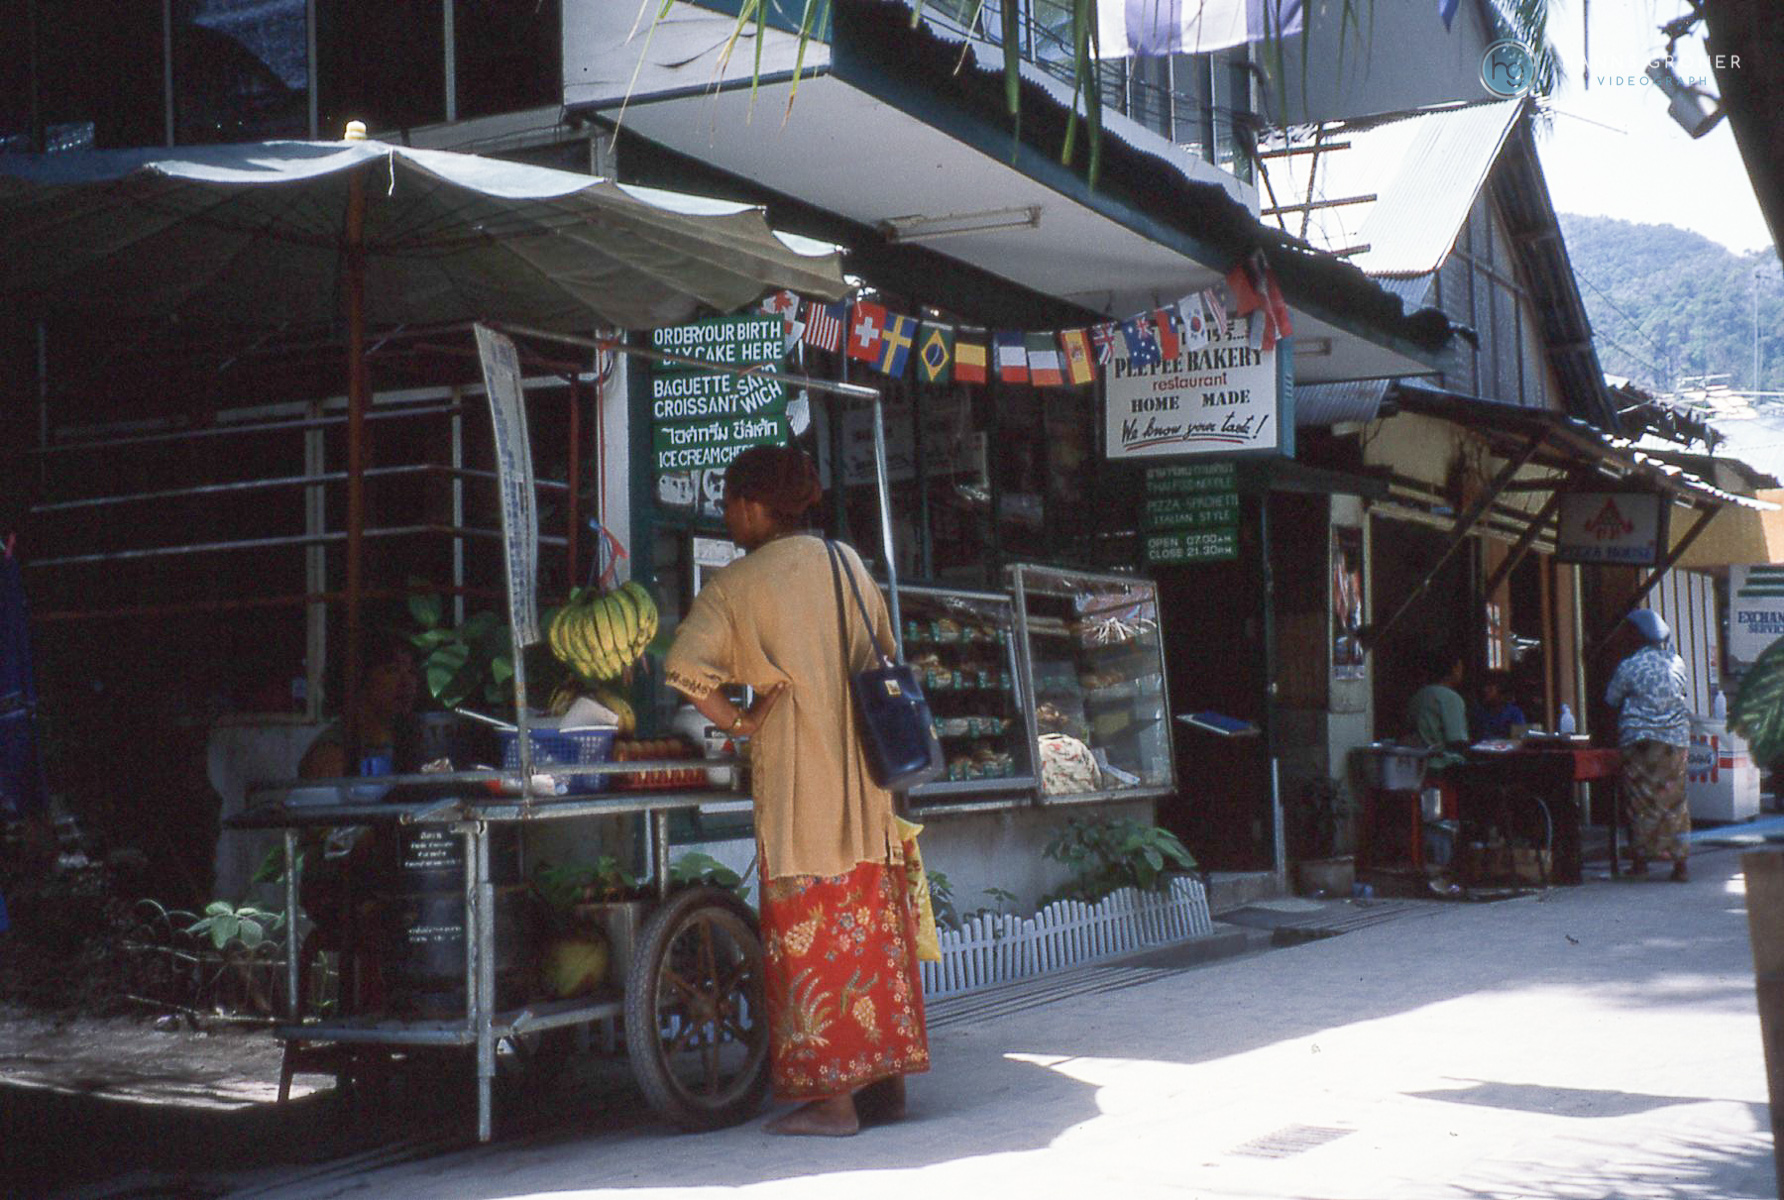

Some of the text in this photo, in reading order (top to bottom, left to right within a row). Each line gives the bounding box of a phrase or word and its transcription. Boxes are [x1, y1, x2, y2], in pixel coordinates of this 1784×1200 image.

[654, 321, 781, 345] ORDER YOUR BIRTH
[742, 342, 782, 361] HERE
[1187, 346, 1262, 372] BAKERY
[653, 375, 730, 397] BAGUETTE
[1152, 372, 1227, 391] restaurant
[654, 395, 739, 418] CROISSANT
[1131, 389, 1251, 413] HOME MADE
[1121, 418, 1139, 443] We
[1142, 416, 1182, 438] know
[1183, 422, 1216, 440] your
[659, 451, 677, 468] ICE
[678, 447, 720, 467] CREAM
[1147, 537, 1179, 549] OPEN
[1149, 547, 1184, 560] CLOSE
